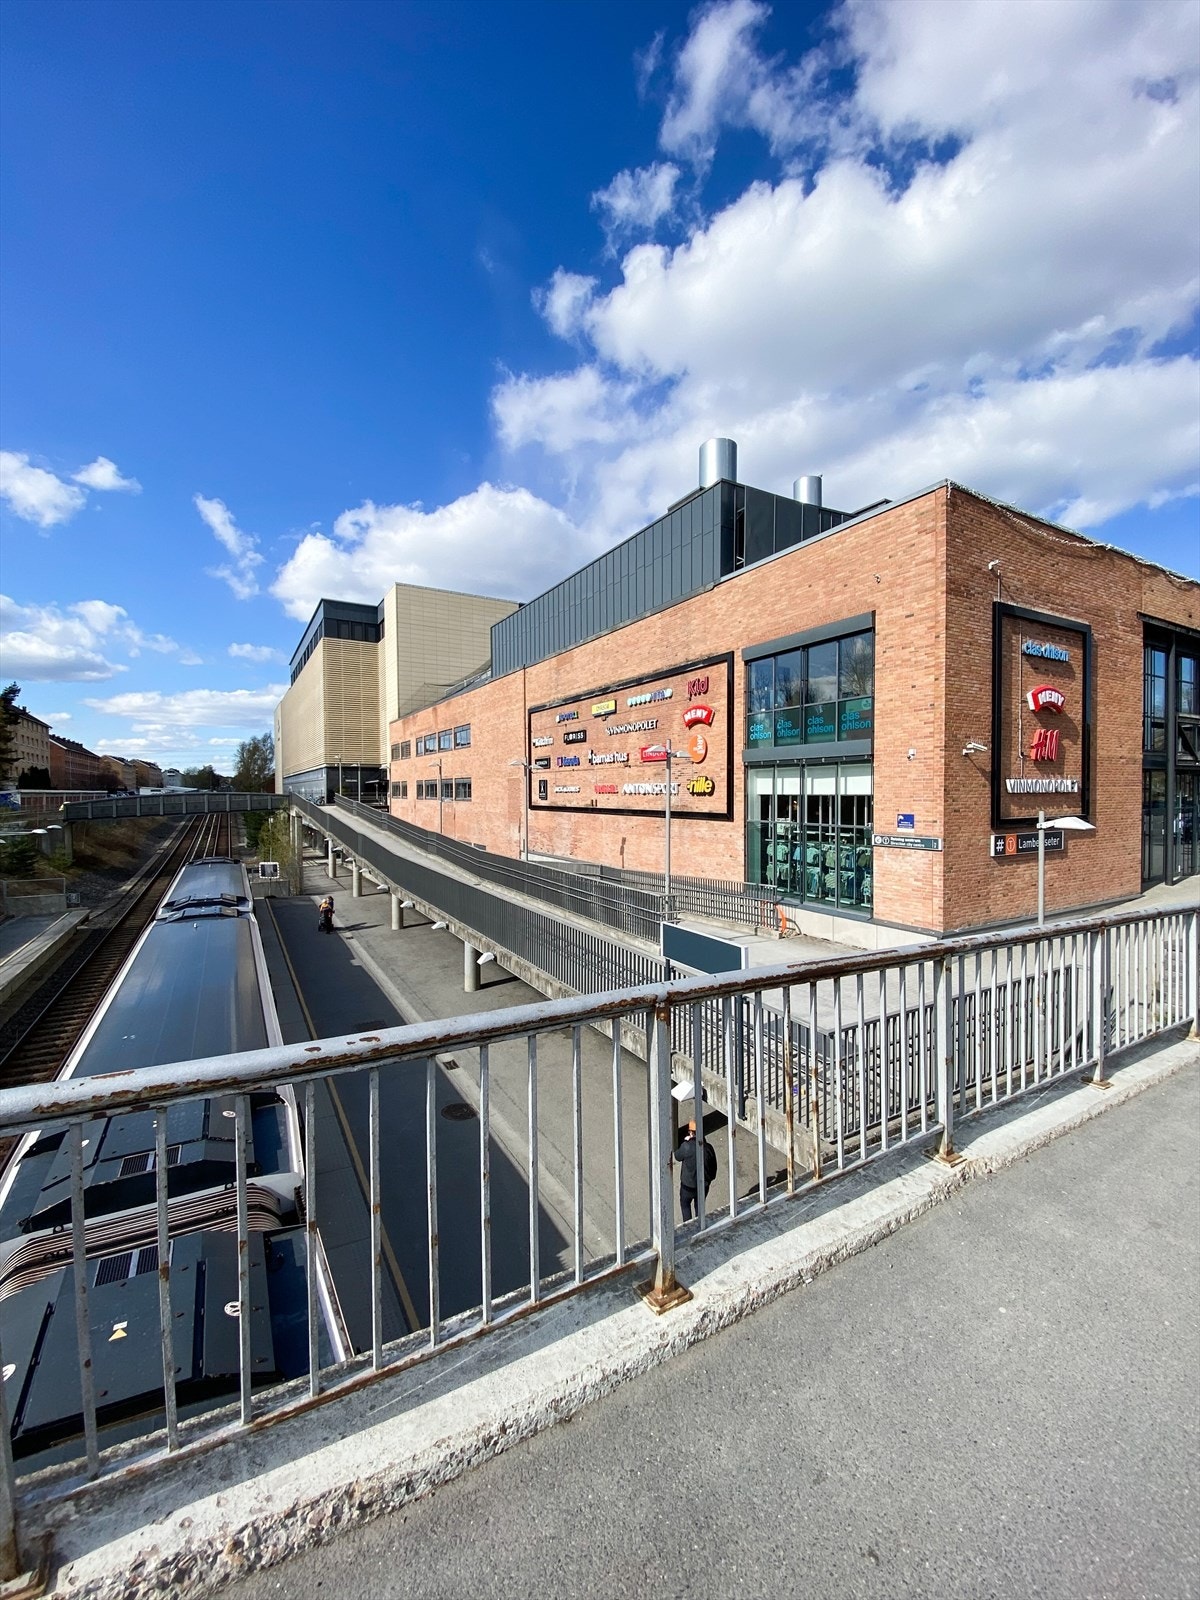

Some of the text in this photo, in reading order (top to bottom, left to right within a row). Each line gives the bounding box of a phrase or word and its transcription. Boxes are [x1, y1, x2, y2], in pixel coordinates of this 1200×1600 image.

[1023, 640, 1069, 661] clas ohlson
[1037, 690, 1065, 706] MENY
[684, 709, 708, 721] MENY
[841, 711, 860, 721] clas
[777, 719, 792, 730] clas
[808, 716, 824, 726] clas
[841, 719, 871, 731] ohlson
[606, 720, 658, 735] VINMONOPOLET
[750, 723, 764, 732] clas
[777, 728, 800, 738] ohlson
[808, 724, 834, 734] ohlson
[750, 731, 772, 740] ohlson
[689, 776, 713, 793] nille
[1018, 837, 1060, 849] Lambeseter
